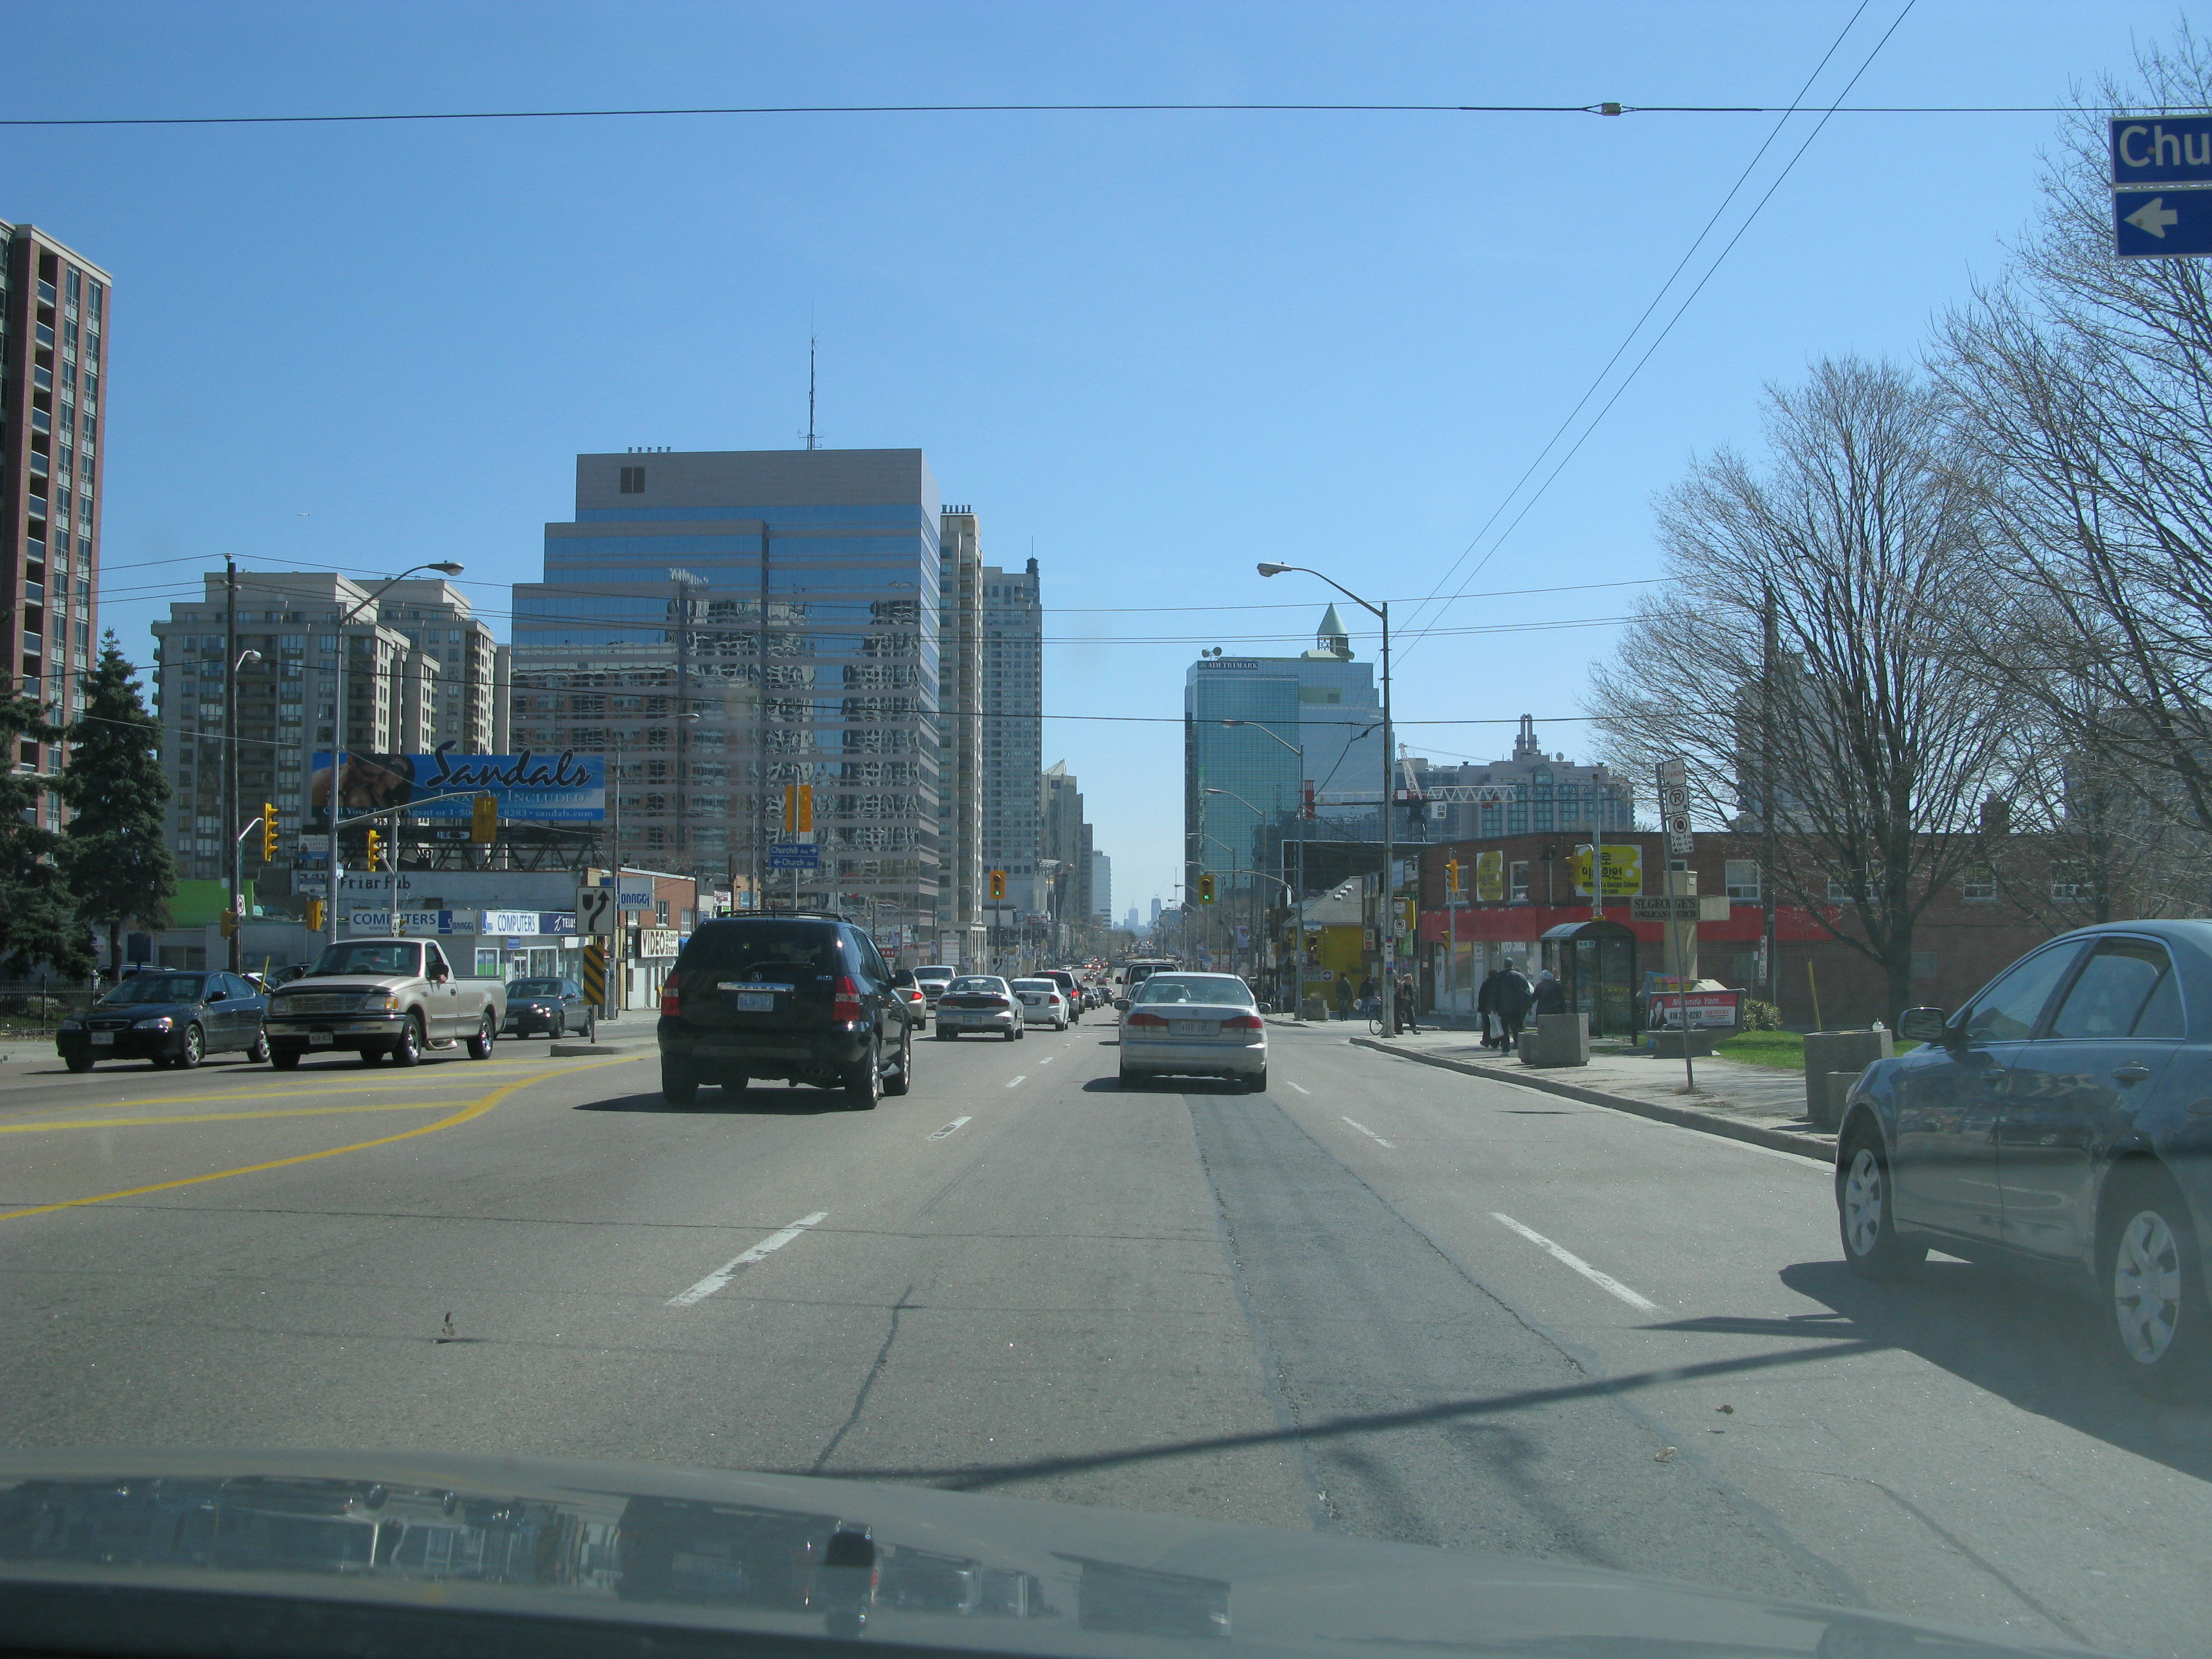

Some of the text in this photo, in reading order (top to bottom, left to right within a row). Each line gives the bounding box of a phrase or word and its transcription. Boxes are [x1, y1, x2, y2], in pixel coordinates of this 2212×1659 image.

[2119, 125, 2211, 168] Chu
[426, 739, 592, 788] Sandals
[508, 789, 585, 802] INCLUDED
[771, 846, 798, 854] Churchill
[1582, 867, 1622, 880] 미학원
[340, 874, 381, 889] Friar
[353, 914, 436, 925] COMTERS
[498, 914, 535, 932] COMPUTERS
[643, 931, 677, 955] VIDEO Super
[666, 945, 677, 955] Store
